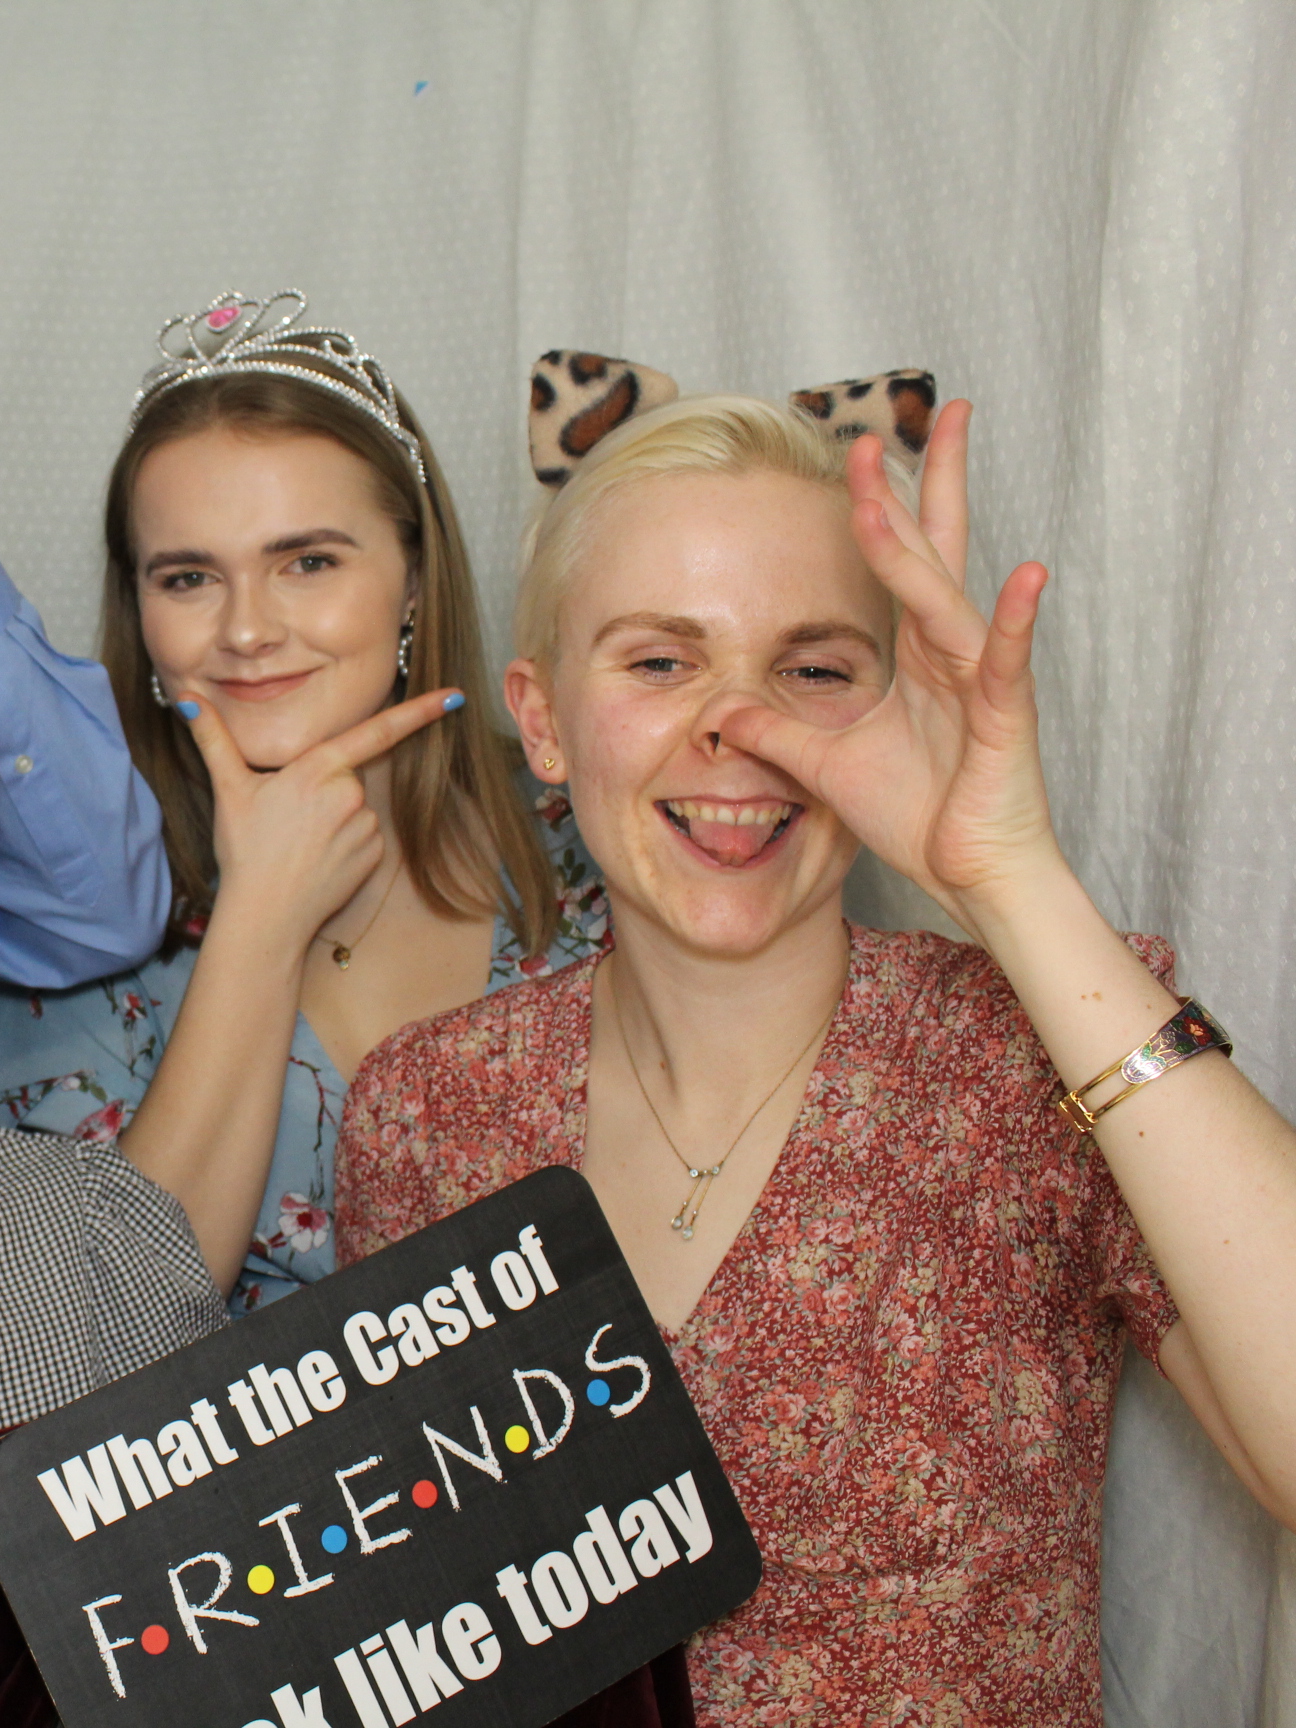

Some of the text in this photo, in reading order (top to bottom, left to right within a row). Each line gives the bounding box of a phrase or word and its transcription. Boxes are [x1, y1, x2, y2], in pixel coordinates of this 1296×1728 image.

[36, 1223, 559, 1541] What the Cast of
[333, 1602, 502, 1728] like
[495, 1470, 713, 1645] today
